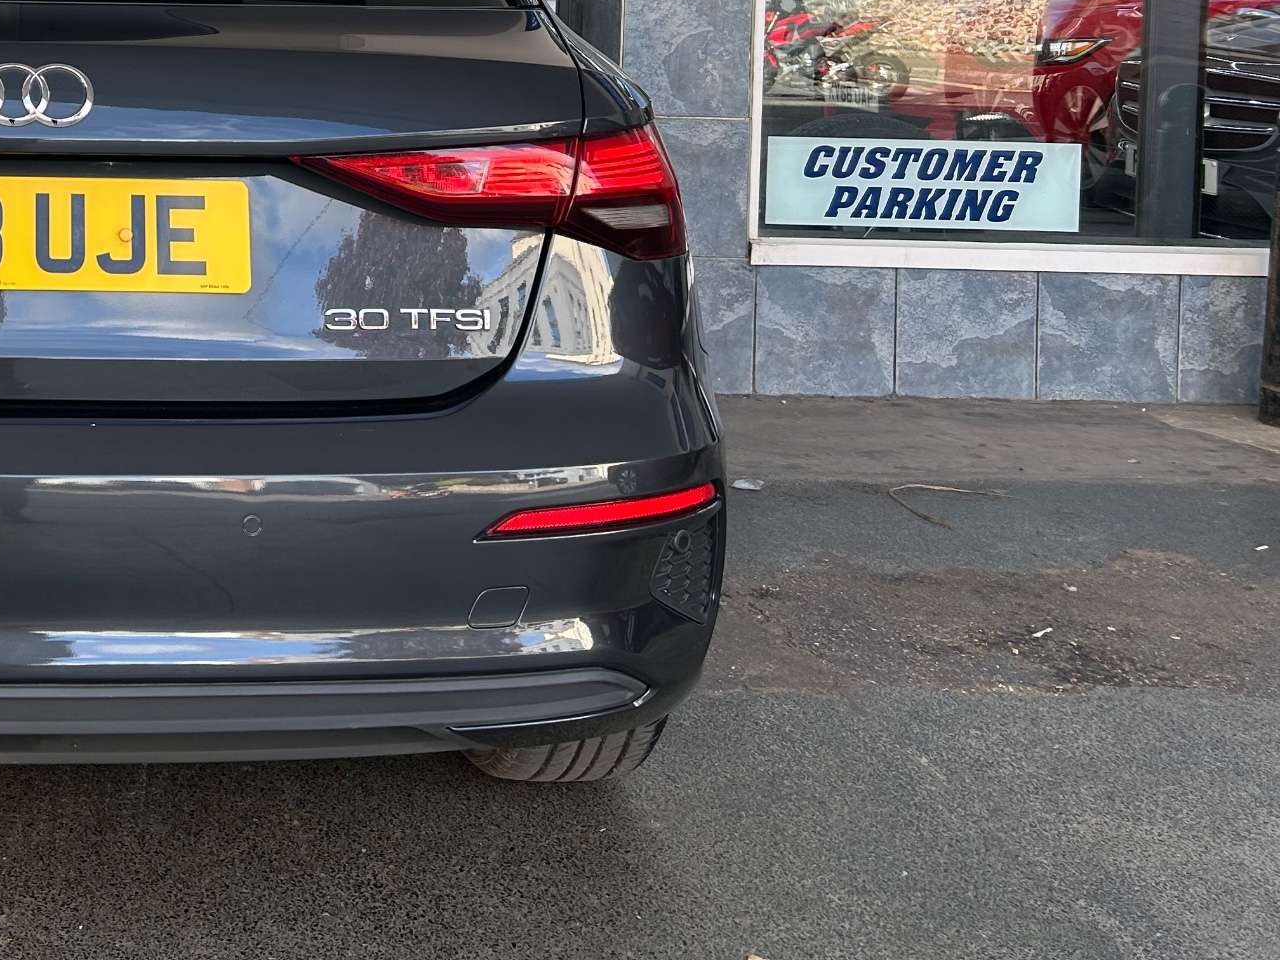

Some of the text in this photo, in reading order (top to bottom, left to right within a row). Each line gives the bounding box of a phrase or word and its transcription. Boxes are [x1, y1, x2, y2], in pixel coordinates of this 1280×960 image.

[803, 144, 1044, 183] CUSTOMER
[824, 186, 1020, 222] PARKING
[35, 193, 208, 276] UJE
[324, 308, 491, 331] 30 TFSI
